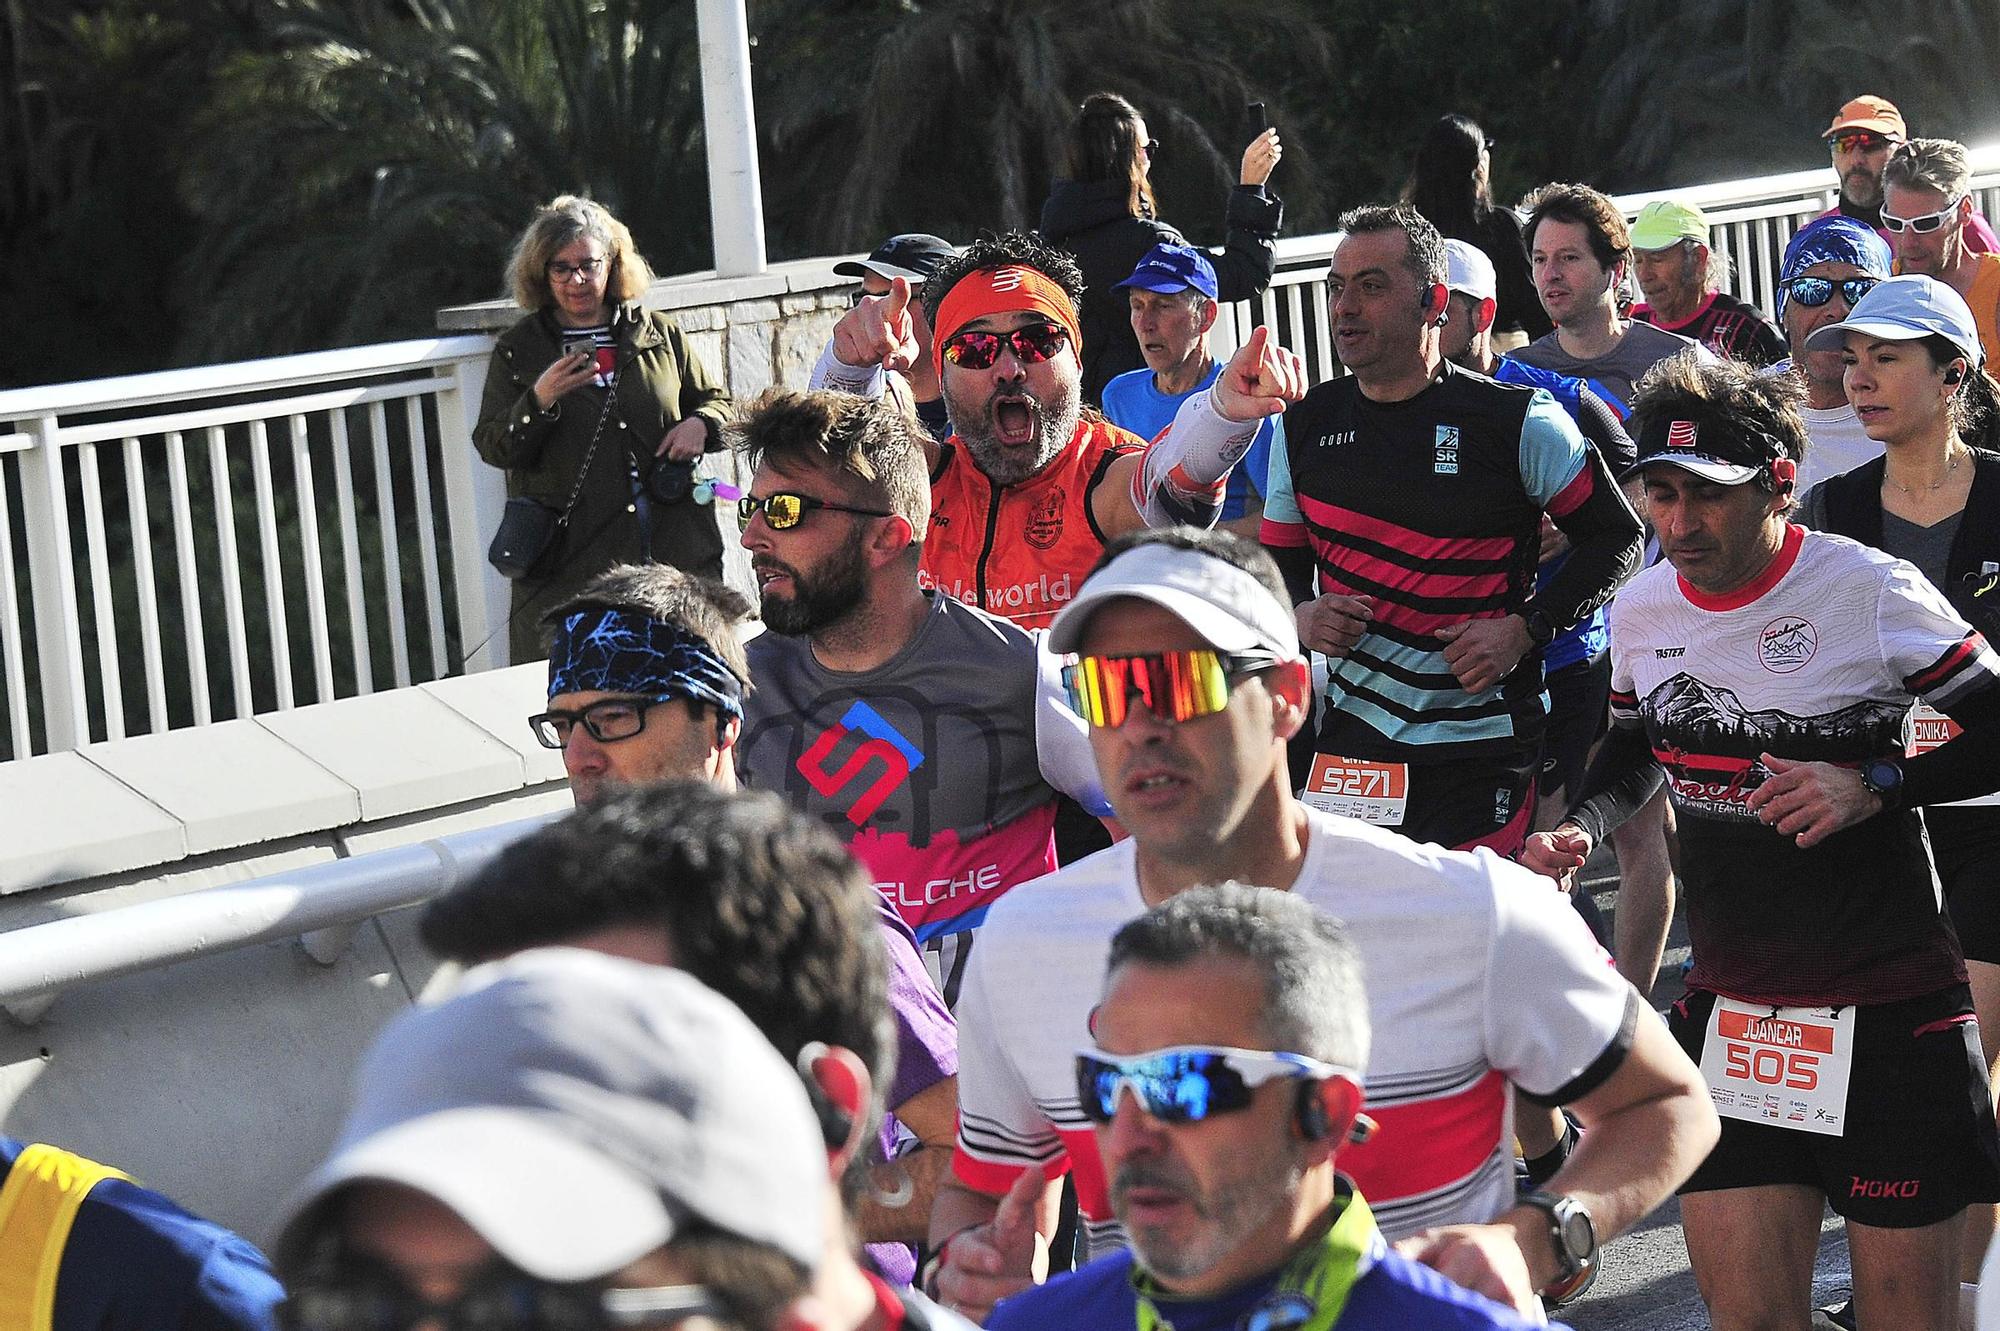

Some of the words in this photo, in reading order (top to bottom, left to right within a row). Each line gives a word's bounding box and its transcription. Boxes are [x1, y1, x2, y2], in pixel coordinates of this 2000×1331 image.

[1319, 430, 1356, 447] GOBIK
[1435, 449, 1458, 462] SR
[1435, 463, 1458, 472] TEAM
[1654, 647, 1686, 660] FASTER
[1914, 722, 1950, 740] ONIKA
[1320, 766, 1391, 797] 5271
[1713, 802, 1737, 814] TEAM
[1738, 806, 1761, 817] ELCH
[873, 863, 1001, 907] ELCHE
[1742, 1018, 1803, 1047] JUANCAR
[1725, 1042, 1820, 1091] 505
